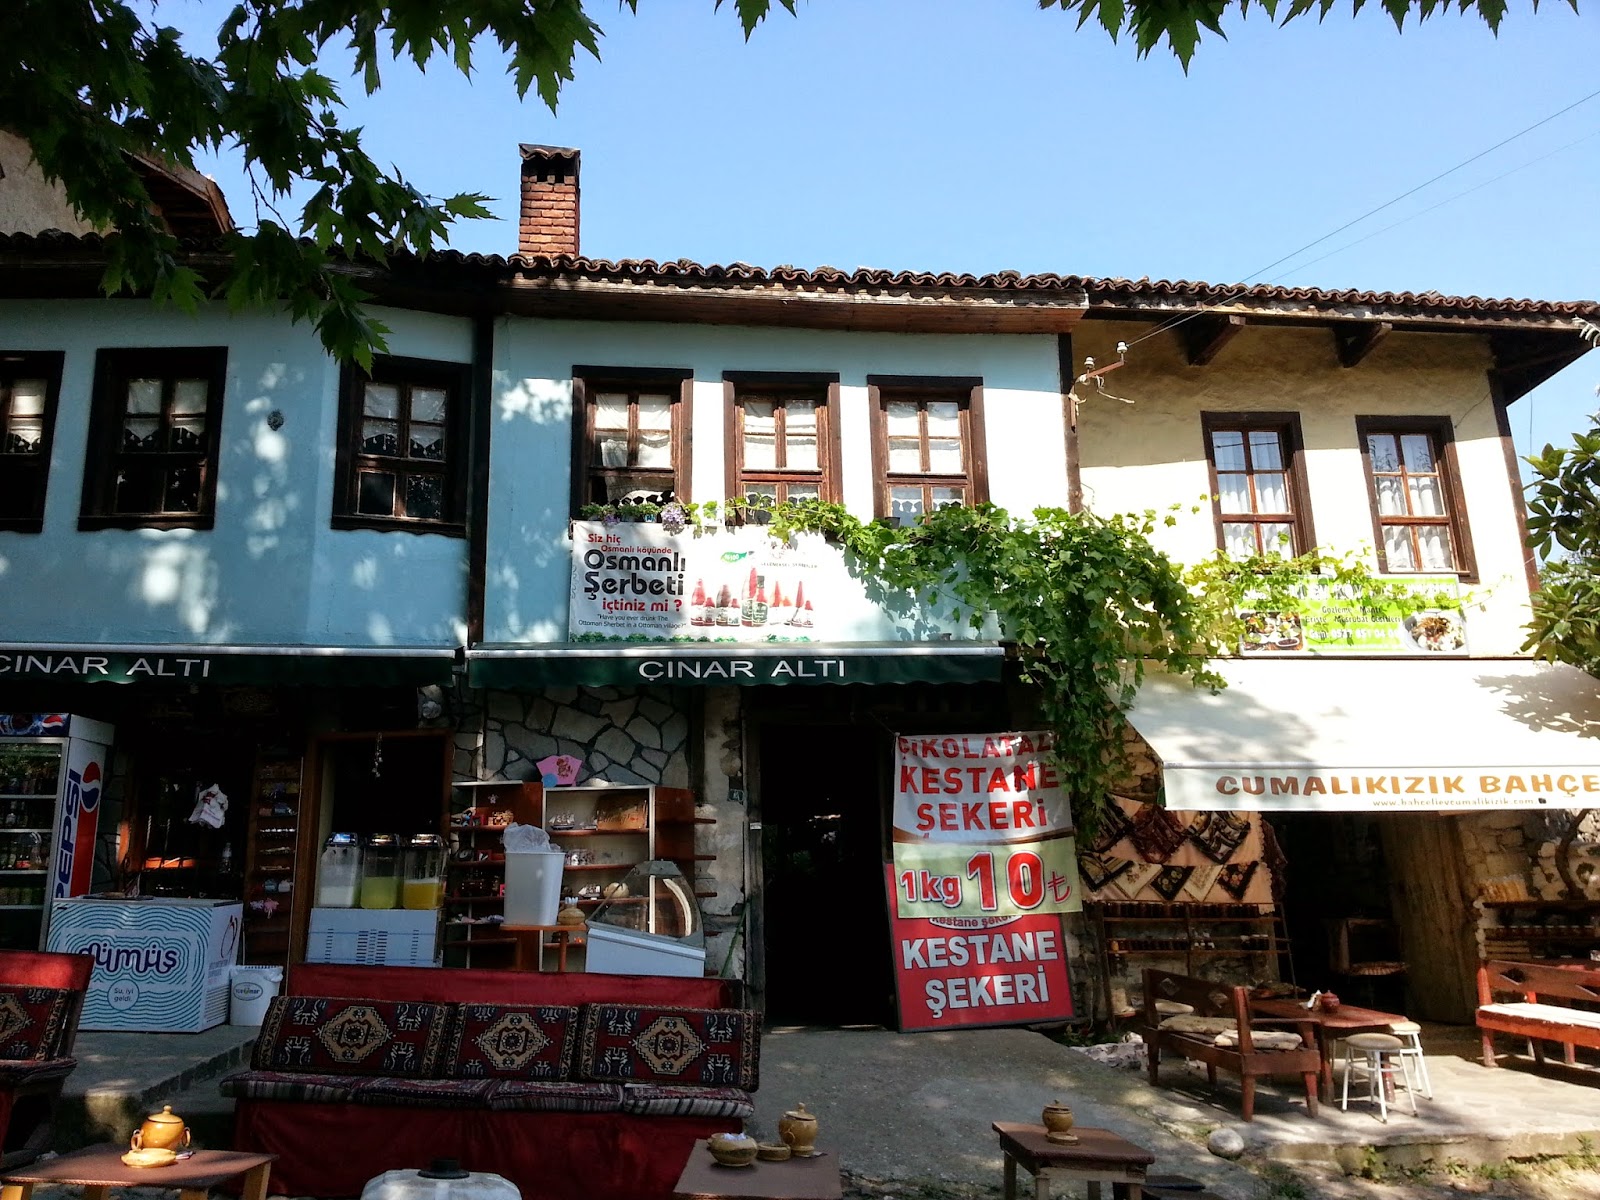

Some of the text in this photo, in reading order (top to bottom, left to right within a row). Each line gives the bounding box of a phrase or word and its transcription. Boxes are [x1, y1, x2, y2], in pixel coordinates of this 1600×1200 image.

[588, 533, 621, 546] Siz hiç
[584, 549, 686, 572] Osmanlı
[584, 571, 684, 600] Şerbeti
[602, 597, 683, 614] içtiniz mi ?
[638, 621, 664, 629] Ottoman
[126, 657, 210, 677] ALTI
[639, 660, 845, 681] ÇINAR ALTI
[901, 763, 1059, 794] KESTANE
[1215, 774, 1600, 798] CUMALIKIZIK BAHÇE
[900, 869, 961, 908] 1kg
[967, 850, 1045, 911] 10
[902, 930, 1058, 970] KESTANE
[925, 965, 1049, 1018] ŞEKERİ
